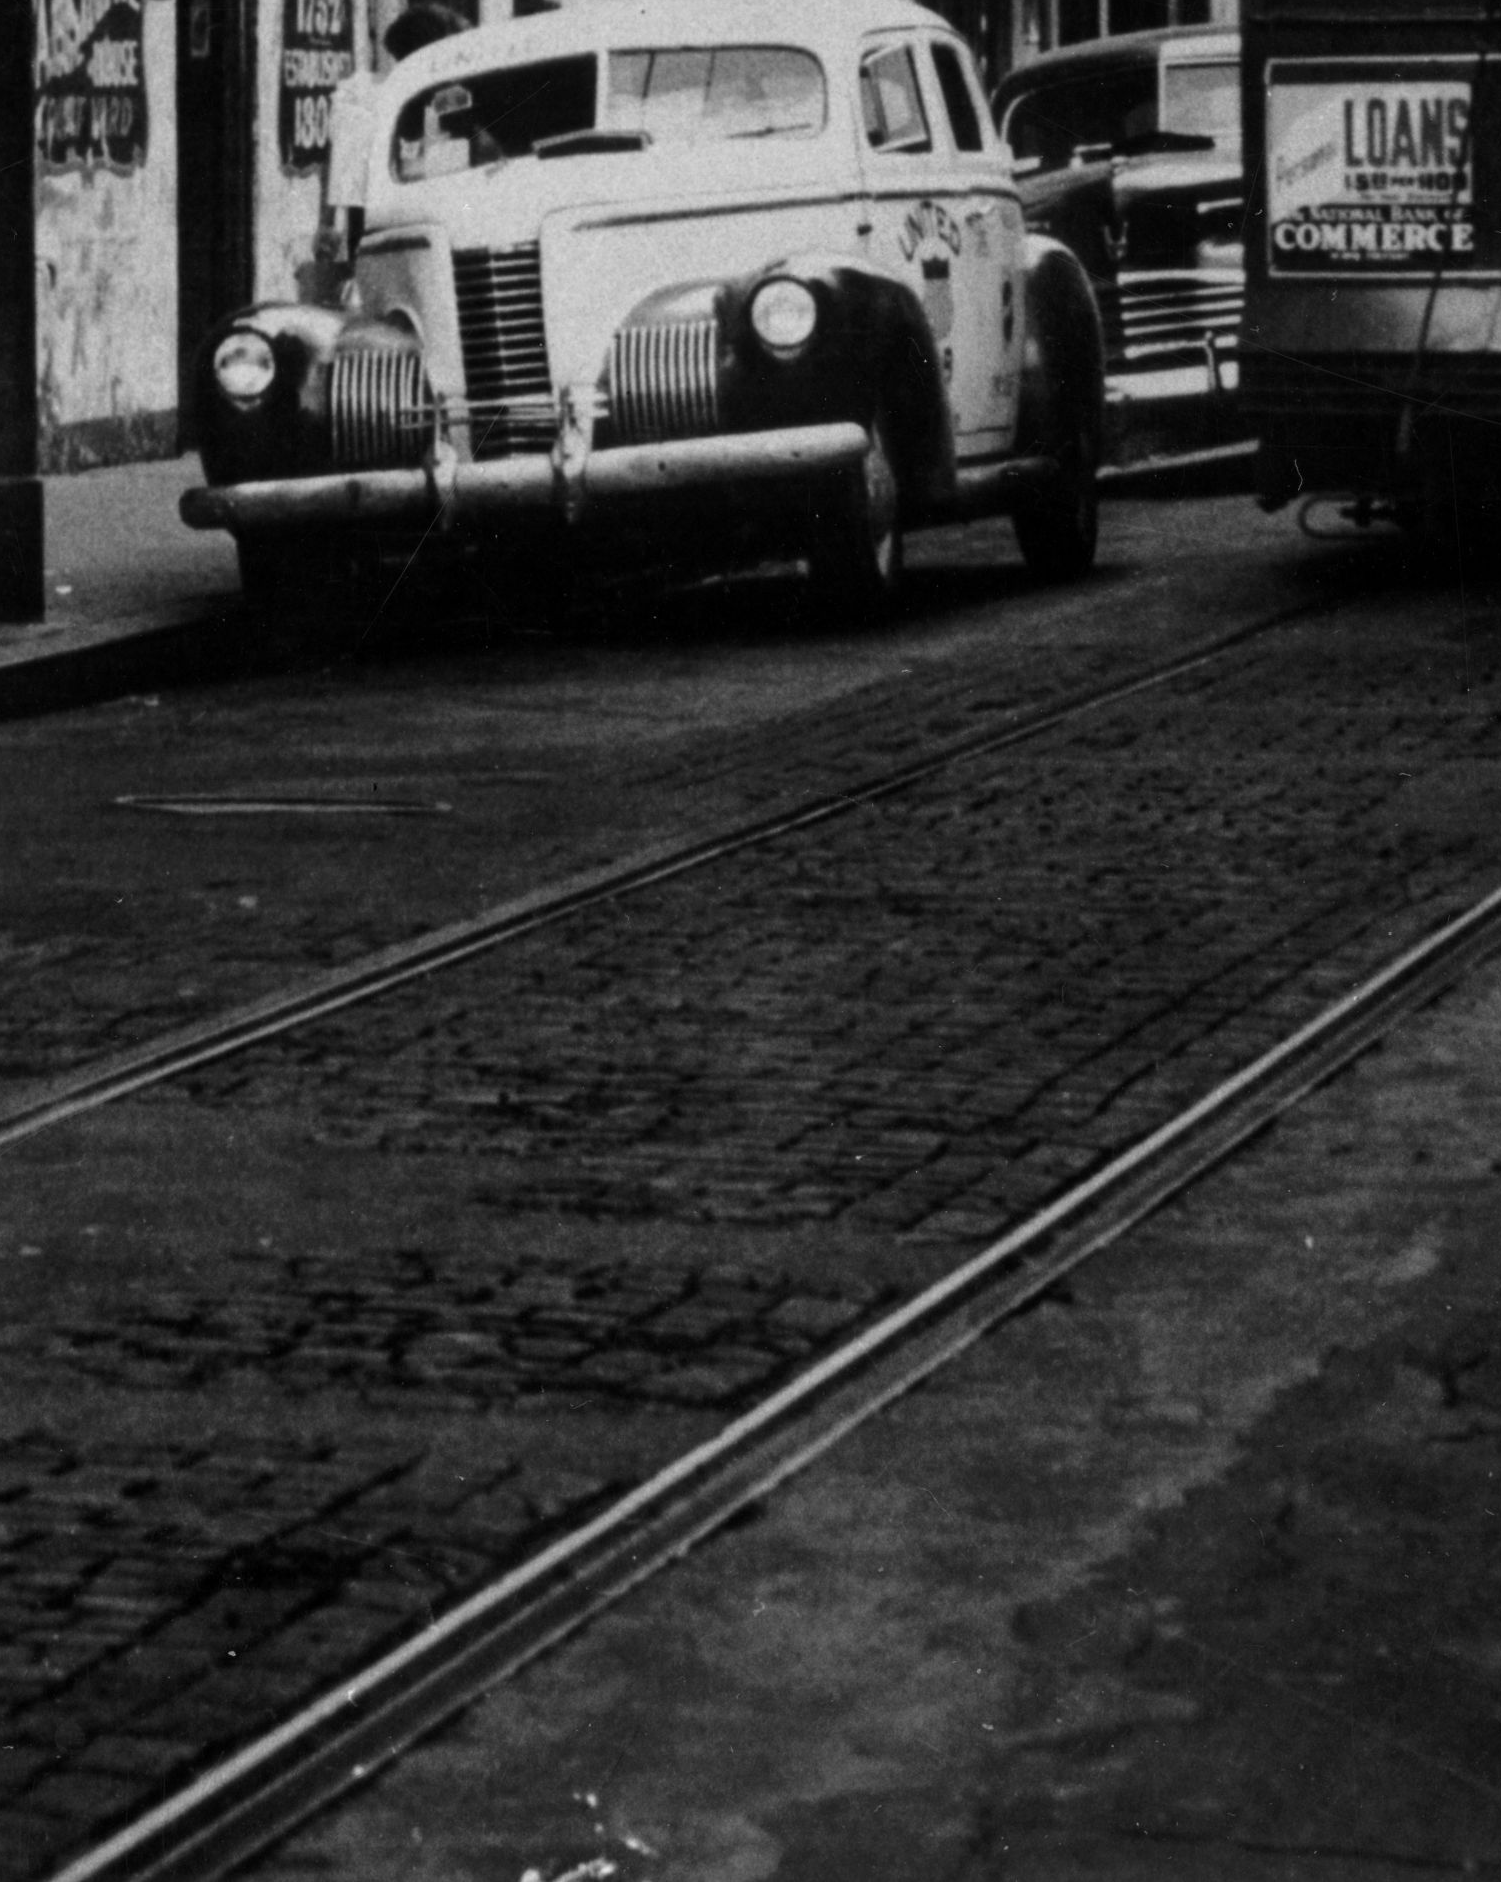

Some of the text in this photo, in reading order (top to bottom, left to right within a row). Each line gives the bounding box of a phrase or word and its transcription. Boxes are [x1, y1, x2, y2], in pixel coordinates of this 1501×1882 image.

[294, 94, 331, 148] 180
[1343, 97, 1470, 168] LOANS
[1390, 204, 1438, 222] BANK
[1273, 222, 1477, 252] COMMERCE
